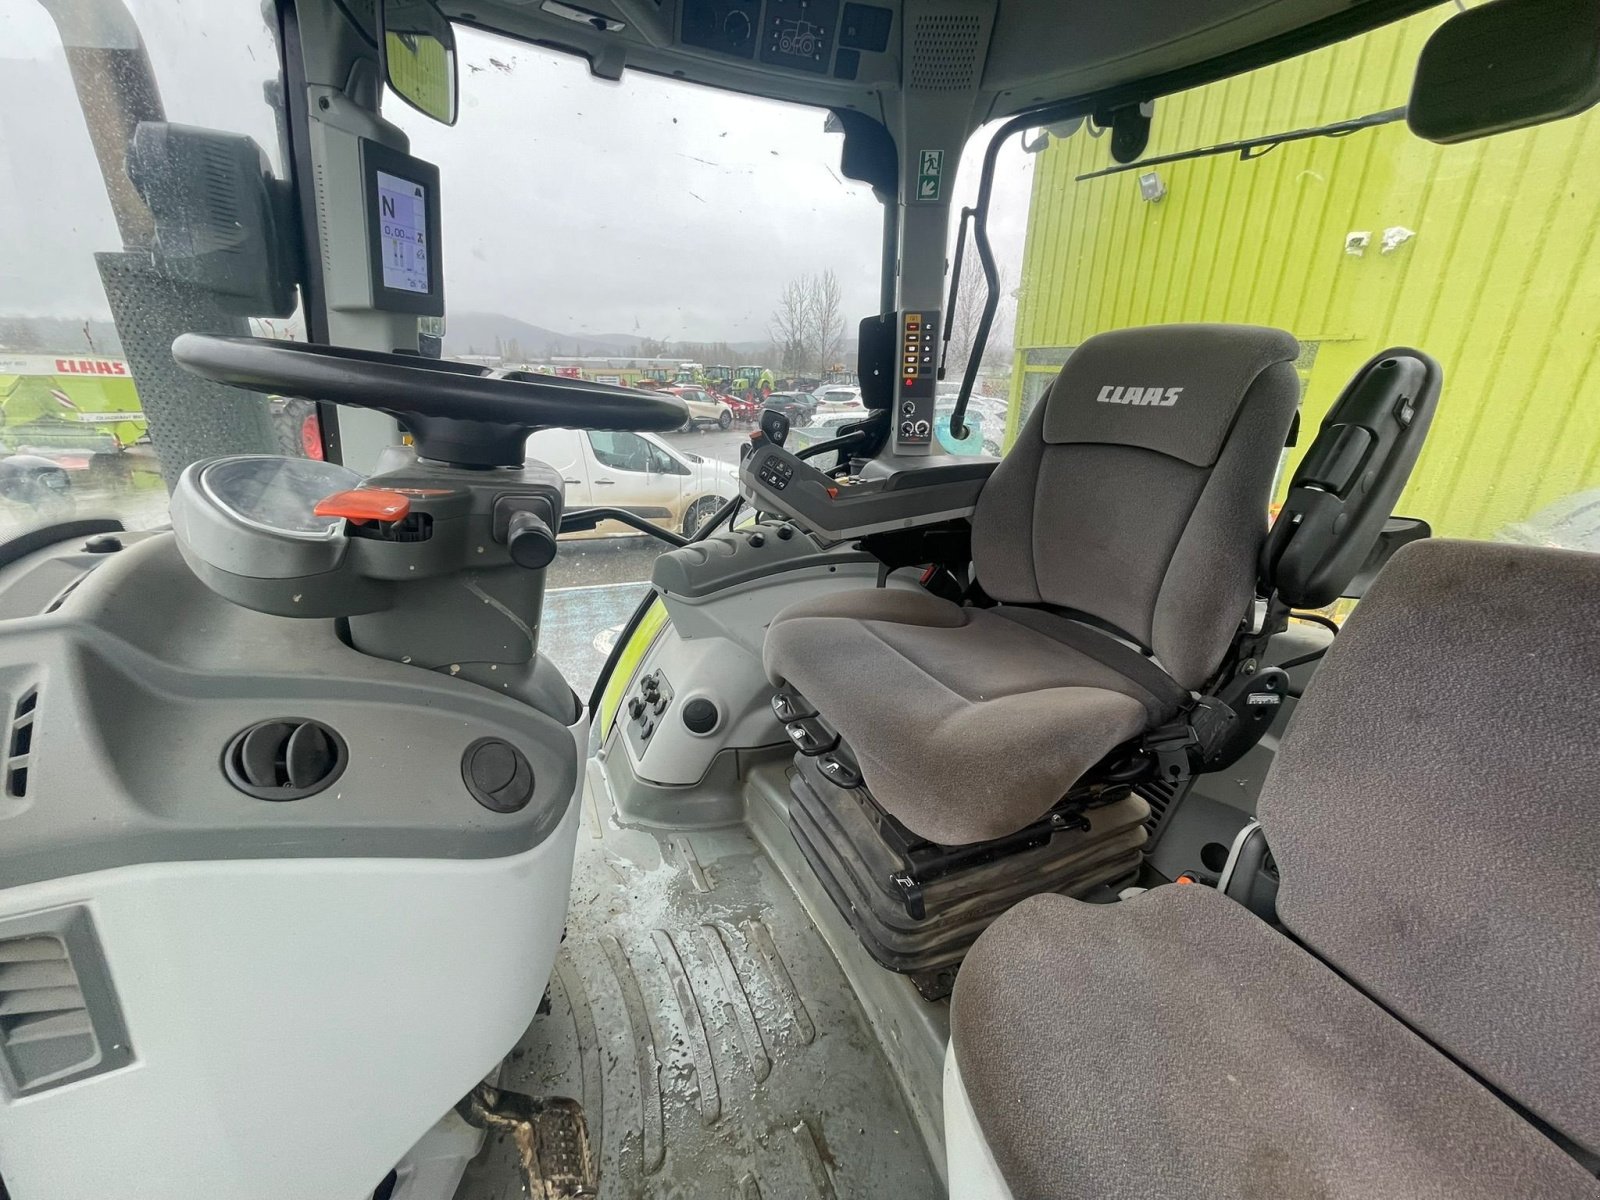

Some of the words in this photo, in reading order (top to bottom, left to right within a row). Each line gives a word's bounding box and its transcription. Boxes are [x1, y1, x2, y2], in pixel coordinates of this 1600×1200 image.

[381, 195, 395, 219] N
[384, 225, 405, 239] 0.00
[55, 359, 126, 375] CLAAS
[1096, 385, 1185, 407] CLAAS
